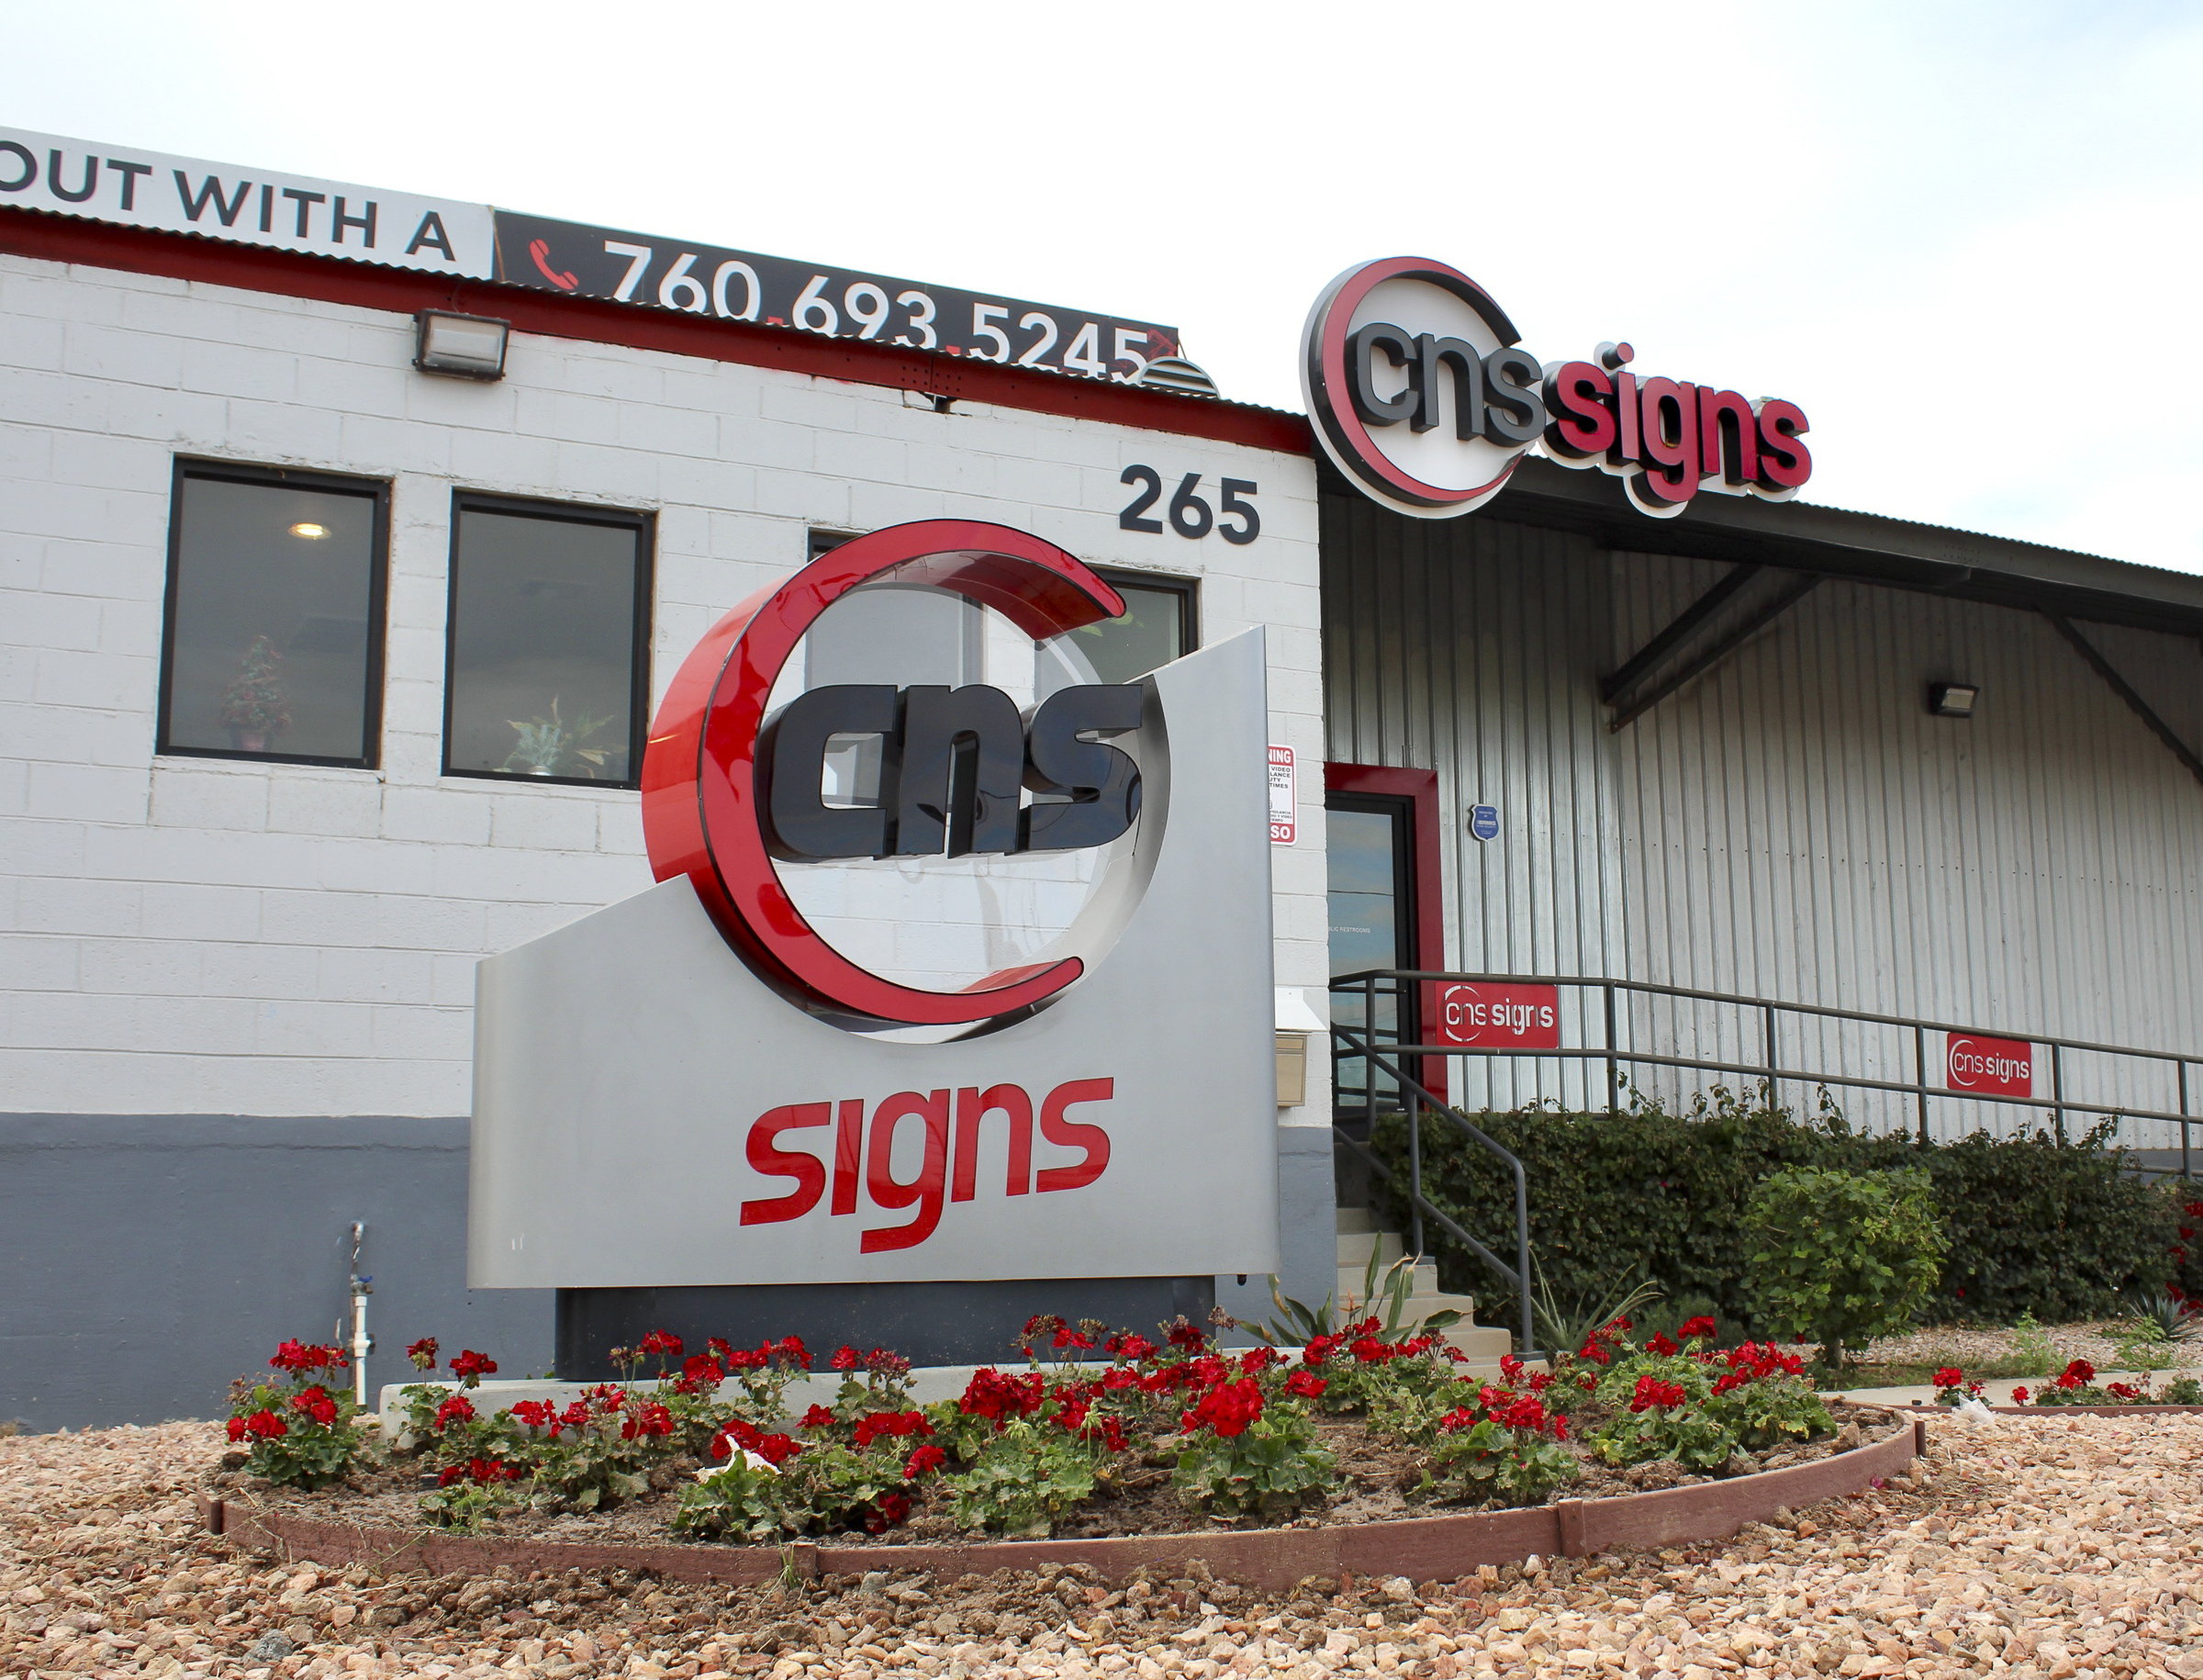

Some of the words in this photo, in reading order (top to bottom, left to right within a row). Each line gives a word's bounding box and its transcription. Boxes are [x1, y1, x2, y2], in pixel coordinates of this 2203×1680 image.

[0, 140, 152, 211] OUT
[172, 169, 377, 249] WITH
[405, 211, 456, 262] A
[1346, 322, 1546, 447] cns
[1544, 342, 1812, 504] signs
[1119, 465, 1260, 544] 265
[753, 684, 1144, 861] cns
[1269, 824, 1292, 840] SO
[1446, 1001, 1487, 1027] cns
[1491, 997, 1554, 1036] signs
[1954, 1052, 1984, 1074] cns
[1985, 1052, 2030, 1084] signs
[739, 1077, 1114, 1254] signs
